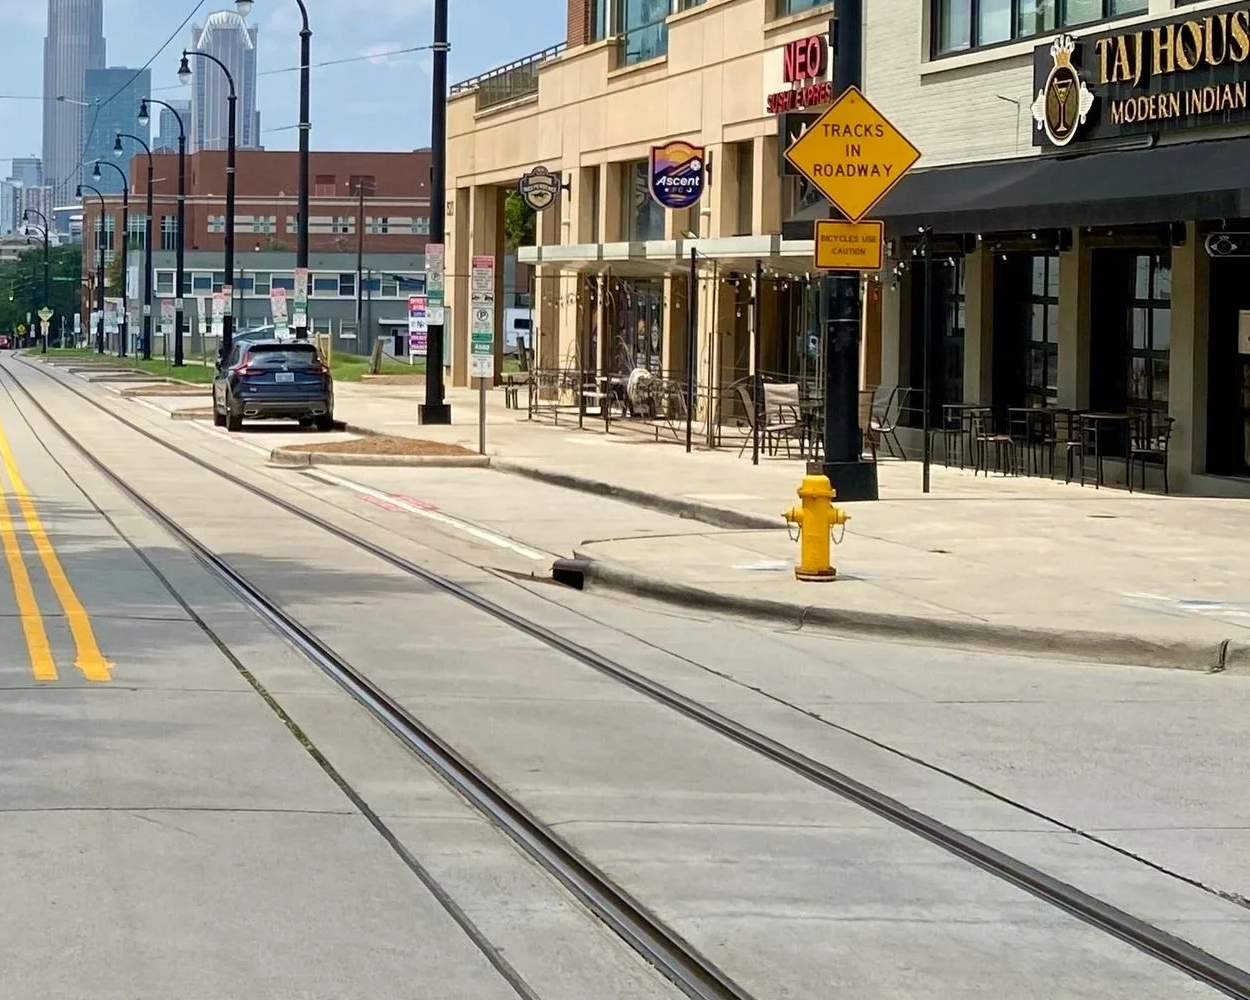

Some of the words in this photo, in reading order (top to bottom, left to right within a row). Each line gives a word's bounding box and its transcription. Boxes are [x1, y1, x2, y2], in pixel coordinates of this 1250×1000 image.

[1095, 31, 1143, 88] TAJ
[1151, 10, 1250, 76] HOUS
[784, 36, 822, 83] NEO
[766, 90, 796, 114] SUSHI
[1111, 90, 1181, 124] MODERN
[1185, 81, 1247, 116] INDIAN
[822, 123, 884, 138] TRACKS
[845, 144, 861, 157] IN
[813, 164, 893, 177] ROADWAY
[655, 175, 700, 186] Ascent
[820, 235, 858, 243] BICYCLES
[862, 235, 877, 243] USE
[831, 247, 866, 255] CAUTION
